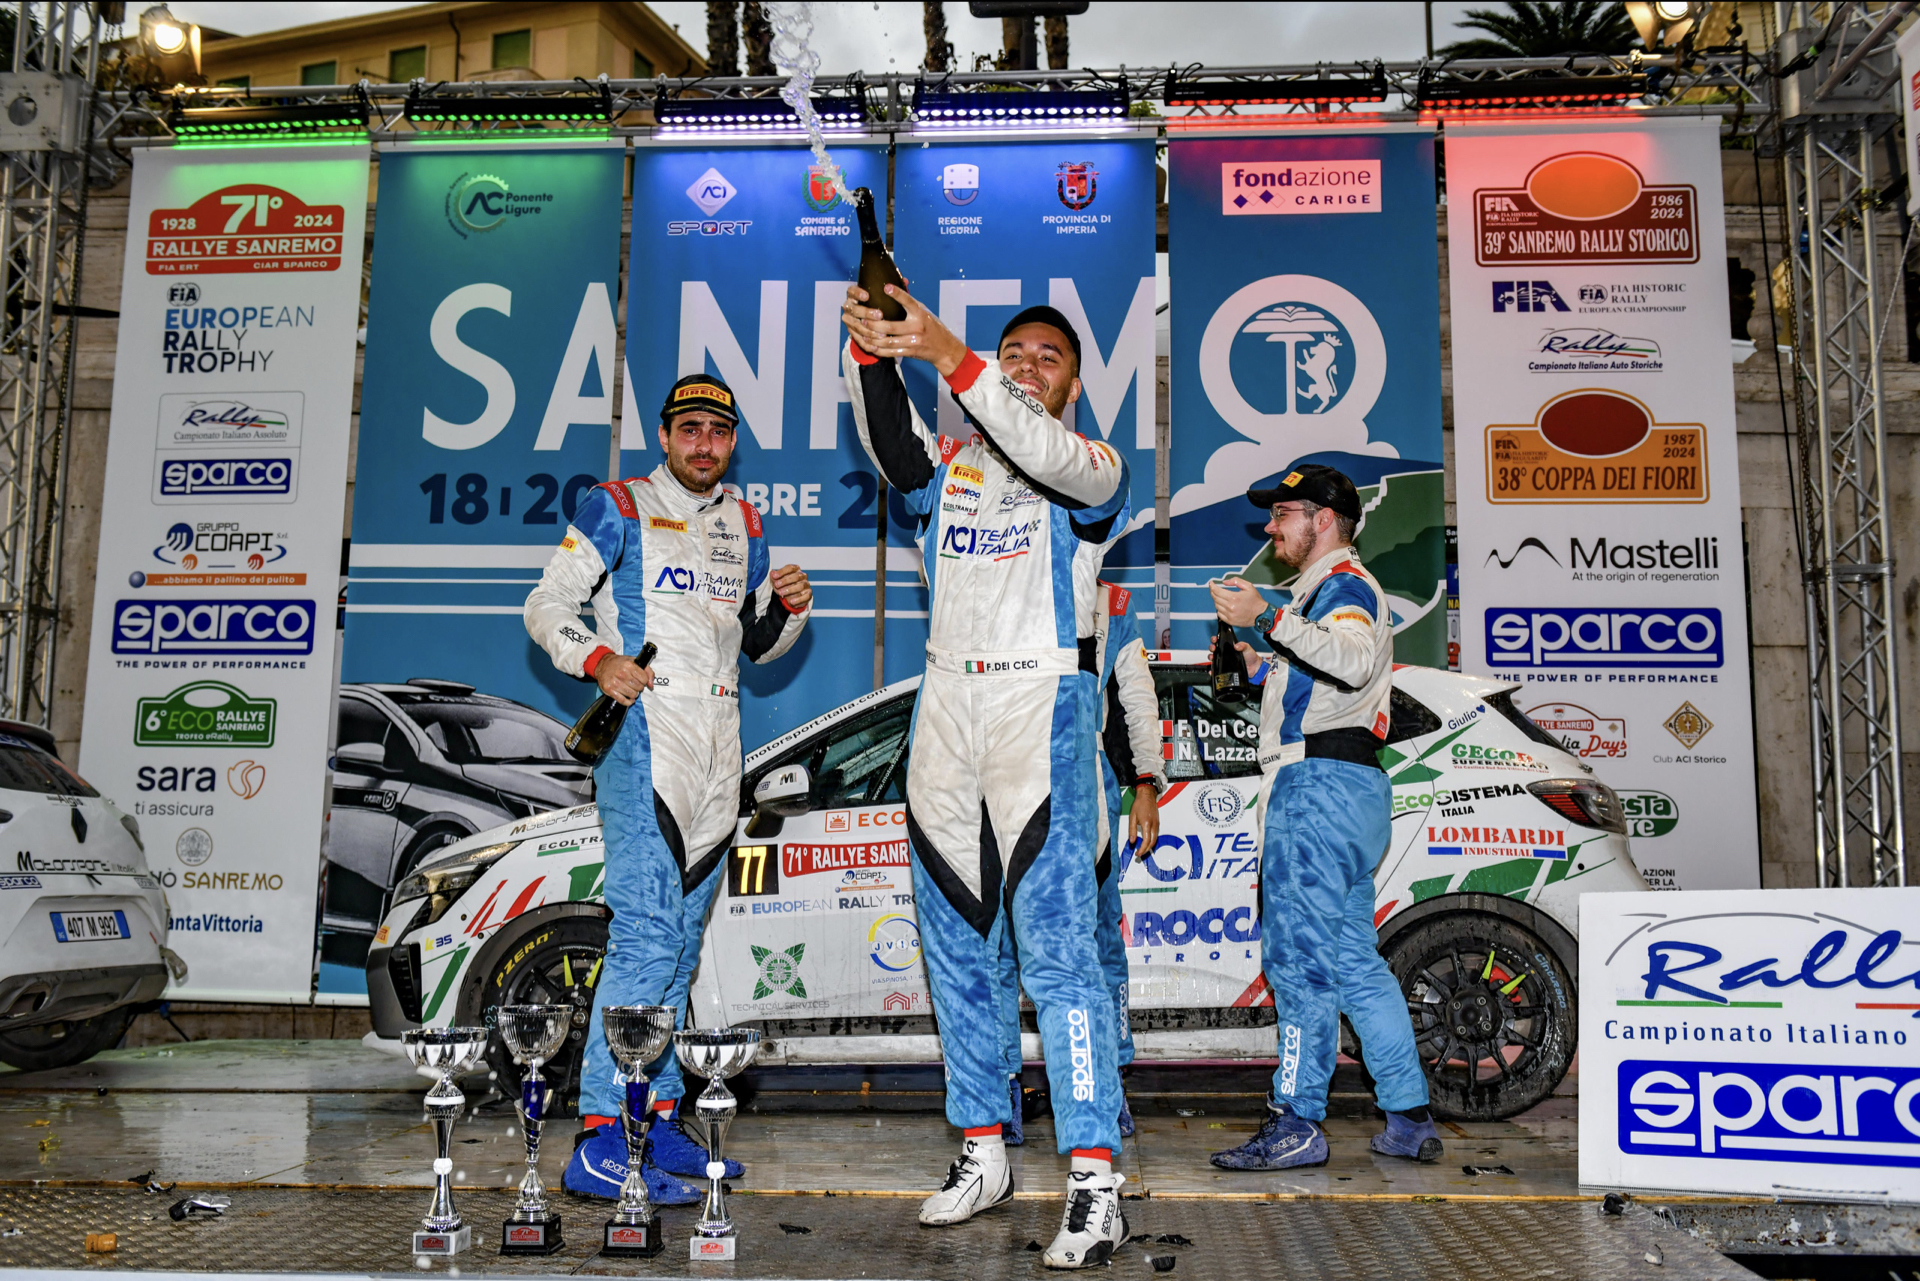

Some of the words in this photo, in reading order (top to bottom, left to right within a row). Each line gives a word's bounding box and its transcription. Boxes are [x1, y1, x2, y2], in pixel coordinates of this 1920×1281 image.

[1233, 167, 1371, 187] fondazione
[506, 193, 554, 202] Ponente
[701, 186, 727, 198] ACI
[1295, 195, 1370, 205] CARIGE
[1485, 197, 1519, 211] FIA
[1651, 195, 1683, 206] 1986
[505, 205, 541, 217] Ligure
[1651, 208, 1683, 219] 2024
[161, 218, 196, 230] 1928
[294, 215, 332, 227] 2024
[938, 217, 982, 225] REGIONE
[1043, 215, 1098, 224] PROVINCIA
[1101, 215, 1111, 223] DI
[667, 221, 752, 235] SPORT
[795, 226, 850, 236] SANREMO
[1057, 226, 1097, 234] IMPERIA
[152, 240, 228, 256] RALLYE
[236, 238, 336, 254] SANREMO
[1509, 230, 1575, 254] SANREMO
[1581, 230, 1624, 253] RALLY
[1629, 228, 1689, 251] STORICO
[283, 260, 327, 268] SPARCO
[1492, 281, 1572, 312] FIA
[1611, 285, 1629, 293] FIA
[1633, 284, 1686, 292] HISTORIC
[1611, 295, 1647, 304] RALLY
[165, 305, 314, 329] EUROPEAN
[164, 329, 247, 351] RALLY
[1541, 334, 1631, 357] Rally
[163, 350, 273, 373] TROPHY
[1529, 361, 1576, 372] Campionato
[1579, 361, 1608, 370] Italiano
[1610, 361, 1628, 370] Auto
[1631, 361, 1663, 369] Storiche
[678, 386, 726, 402] PIRELLI
[183, 407, 262, 430] Rally
[174, 431, 220, 442] Campionato
[222, 431, 251, 439] Italiano
[254, 431, 287, 439] Assoluto
[1663, 434, 1695, 445] 1987
[1663, 447, 1695, 458] 2024
[165, 462, 287, 493] sparco
[1532, 466, 1596, 490] COPPA
[1603, 467, 1636, 489] DEI
[1643, 466, 1696, 489] FIORI
[420, 473, 489, 524] 18
[197, 523, 239, 531] GRUPPO
[195, 533, 273, 551] COAPI
[942, 525, 976, 554] ACI
[980, 523, 1028, 542] TEAM
[976, 536, 1030, 555] ITALIA
[1570, 537, 1718, 569] Mastelli
[206, 576, 212, 584] il
[215, 576, 247, 585] pallino
[267, 575, 295, 584] pulito
[655, 566, 694, 591] ACI
[1572, 572, 1583, 581] At
[1586, 572, 1604, 581] the
[1606, 572, 1635, 583] origin
[1638, 572, 1648, 581] of
[1651, 572, 1719, 583] regeneration
[119, 605, 309, 652] sparco
[1492, 613, 1716, 664] sparco
[213, 661, 306, 669] PERFORMANCE
[1013, 660, 1038, 670] CECI
[1527, 674, 1577, 682] POWER
[1609, 675, 1718, 683] PERFORMANCE
[168, 711, 214, 730] ECO
[216, 711, 266, 722] RALLYE
[216, 723, 265, 731] SANREMO
[1448, 710, 1477, 730] Giulio
[1557, 721, 1591, 729] SANREMO
[1178, 720, 1191, 737] F.
[1198, 720, 1226, 738] Dei
[1179, 742, 1197, 760] N.
[1204, 742, 1259, 761] Lazza
[1579, 735, 1627, 757] Days
[1653, 755, 1673, 763] Club
[136, 766, 216, 792] sara
[135, 802, 145, 814] ti
[149, 802, 214, 816] assicura
[1441, 806, 1475, 817] ITALIA
[858, 811, 907, 827] ECO
[1427, 826, 1565, 846] LOMBARDI
[812, 847, 866, 869] RALLYE
[1464, 847, 1532, 857] INDUSTRIAL
[737, 846, 767, 894] 77
[1643, 869, 1675, 877] AZIONI
[183, 872, 283, 890] SANREMO
[752, 899, 832, 915] EUROPEAN
[839, 895, 886, 909] RALLY
[68, 917, 85, 937] 407
[86, 916, 99, 936] M
[98, 916, 118, 936] 992
[1641, 930, 1920, 1019] Rall
[731, 1003, 783, 1011] TECHNICAL
[785, 1001, 830, 1009] SERVICES
[1605, 1020, 1772, 1045] Campionato
[1787, 1023, 1907, 1045] Italiano
[1068, 1009, 1095, 1102] sparco
[1281, 1025, 1300, 1096] sparco
